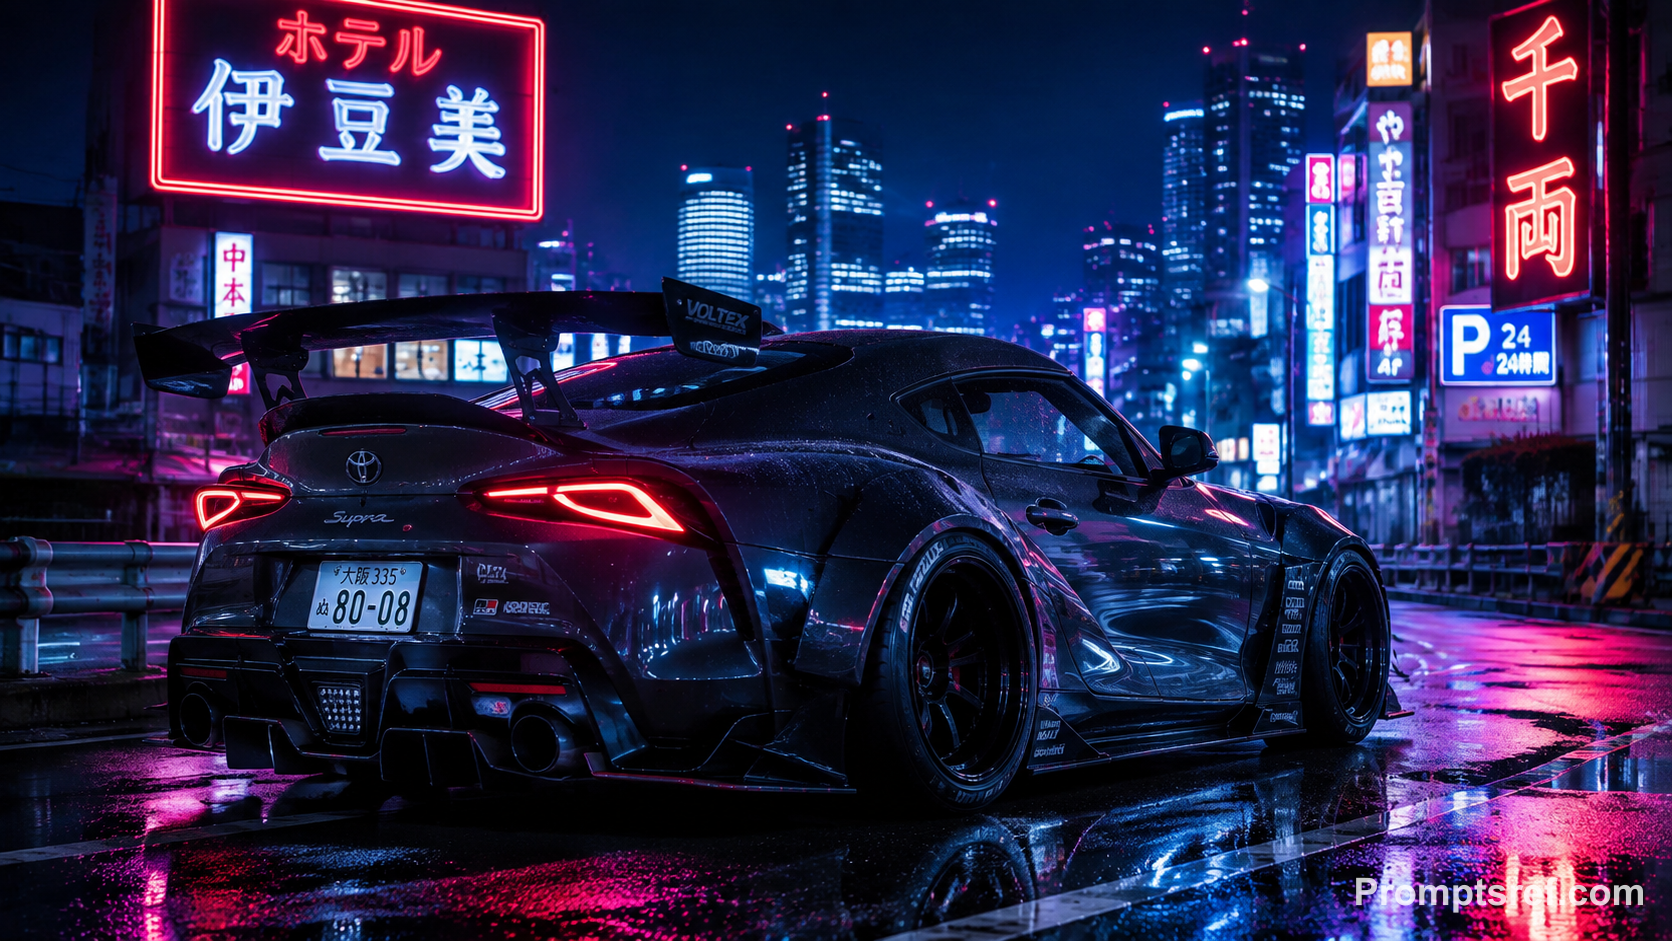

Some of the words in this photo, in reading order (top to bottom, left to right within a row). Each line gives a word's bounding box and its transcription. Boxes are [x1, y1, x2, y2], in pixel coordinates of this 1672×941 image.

[275, 10, 442, 77] ホテル
[190, 58, 507, 180] 伊豆美
[1501, 15, 1579, 281] 千両
[686, 298, 750, 329] VOLTEX
[1452, 314, 1491, 376] P
[1500, 322, 1532, 350] 24
[323, 510, 395, 528] Supra
[340, 566, 371, 586] 大阪
[371, 567, 399, 586] 335
[332, 589, 411, 626] 80-08
